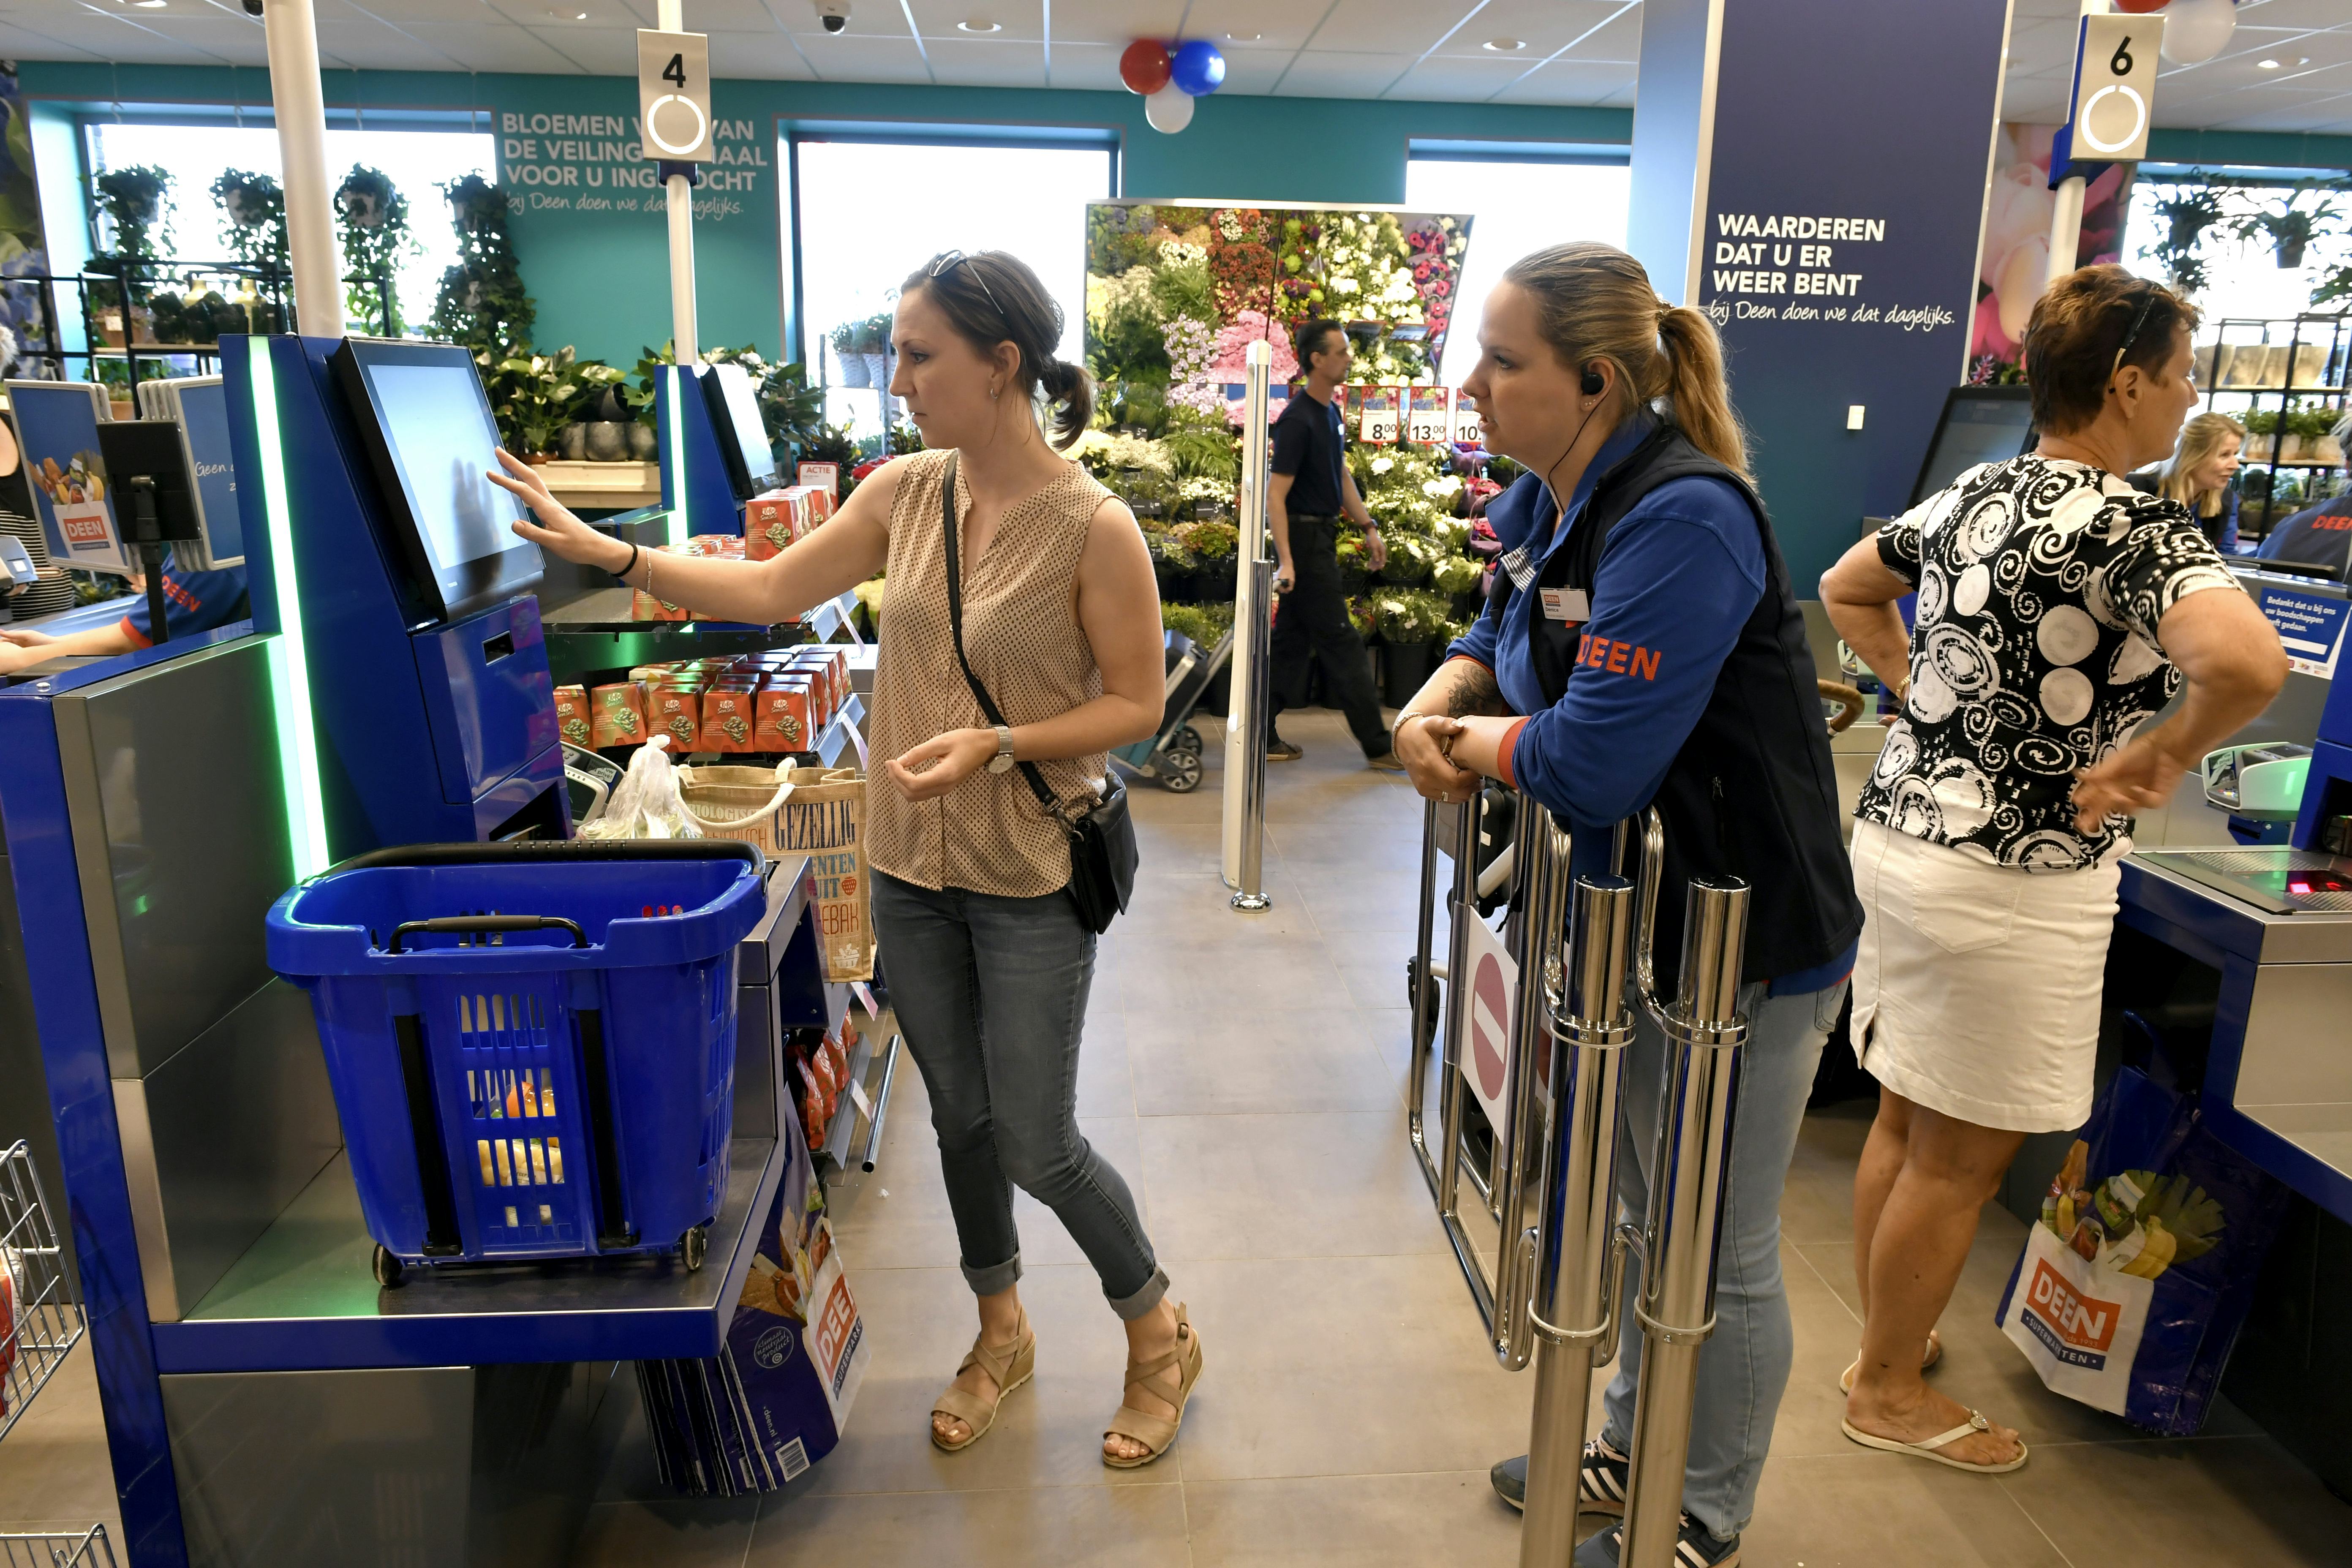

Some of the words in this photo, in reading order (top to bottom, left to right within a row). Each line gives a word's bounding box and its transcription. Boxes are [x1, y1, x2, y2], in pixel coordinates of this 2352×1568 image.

[2111, 36, 2133, 76] 6
[662, 53, 686, 88] 4
[503, 113, 624, 136] BLOEMEN
[504, 139, 537, 159] DE
[545, 140, 643, 162] VEILING
[504, 165, 578, 186] VOOR
[586, 167, 603, 187] U
[612, 168, 757, 191] INGOCHT
[529, 193, 570, 209] Deen
[576, 193, 611, 210] doen
[617, 199, 638, 211] we
[1718, 214, 1885, 241] WAARDEREN
[1715, 242, 1767, 265] DAT
[1774, 244, 1792, 266] U
[1799, 245, 1832, 267] ER
[1713, 270, 1787, 294] WEER
[1794, 272, 1862, 296] BENT
[1710, 299, 1730, 326] bij
[1735, 301, 1777, 319] Deen
[1782, 301, 1819, 320] doen
[1824, 307, 1847, 321] we
[1851, 303, 1880, 322] dat
[1884, 304, 1955, 332] dagelijks.
[195, 461, 227, 477] Geen
[67, 520, 103, 537] DEEN
[162, 575, 202, 612] DEEN
[2267, 596, 2294, 607] Bedankt
[2295, 601, 2307, 610] dat
[2313, 604, 2323, 615] bij
[2276, 608, 2325, 624] boodschappen
[1575, 634, 1661, 681] DEEN
[687, 803, 763, 821] BIOLOGISC
[774, 798, 856, 851] GEZELLIG
[822, 902, 859, 935] EBAK
[2034, 1270, 2107, 1340] DEEN
